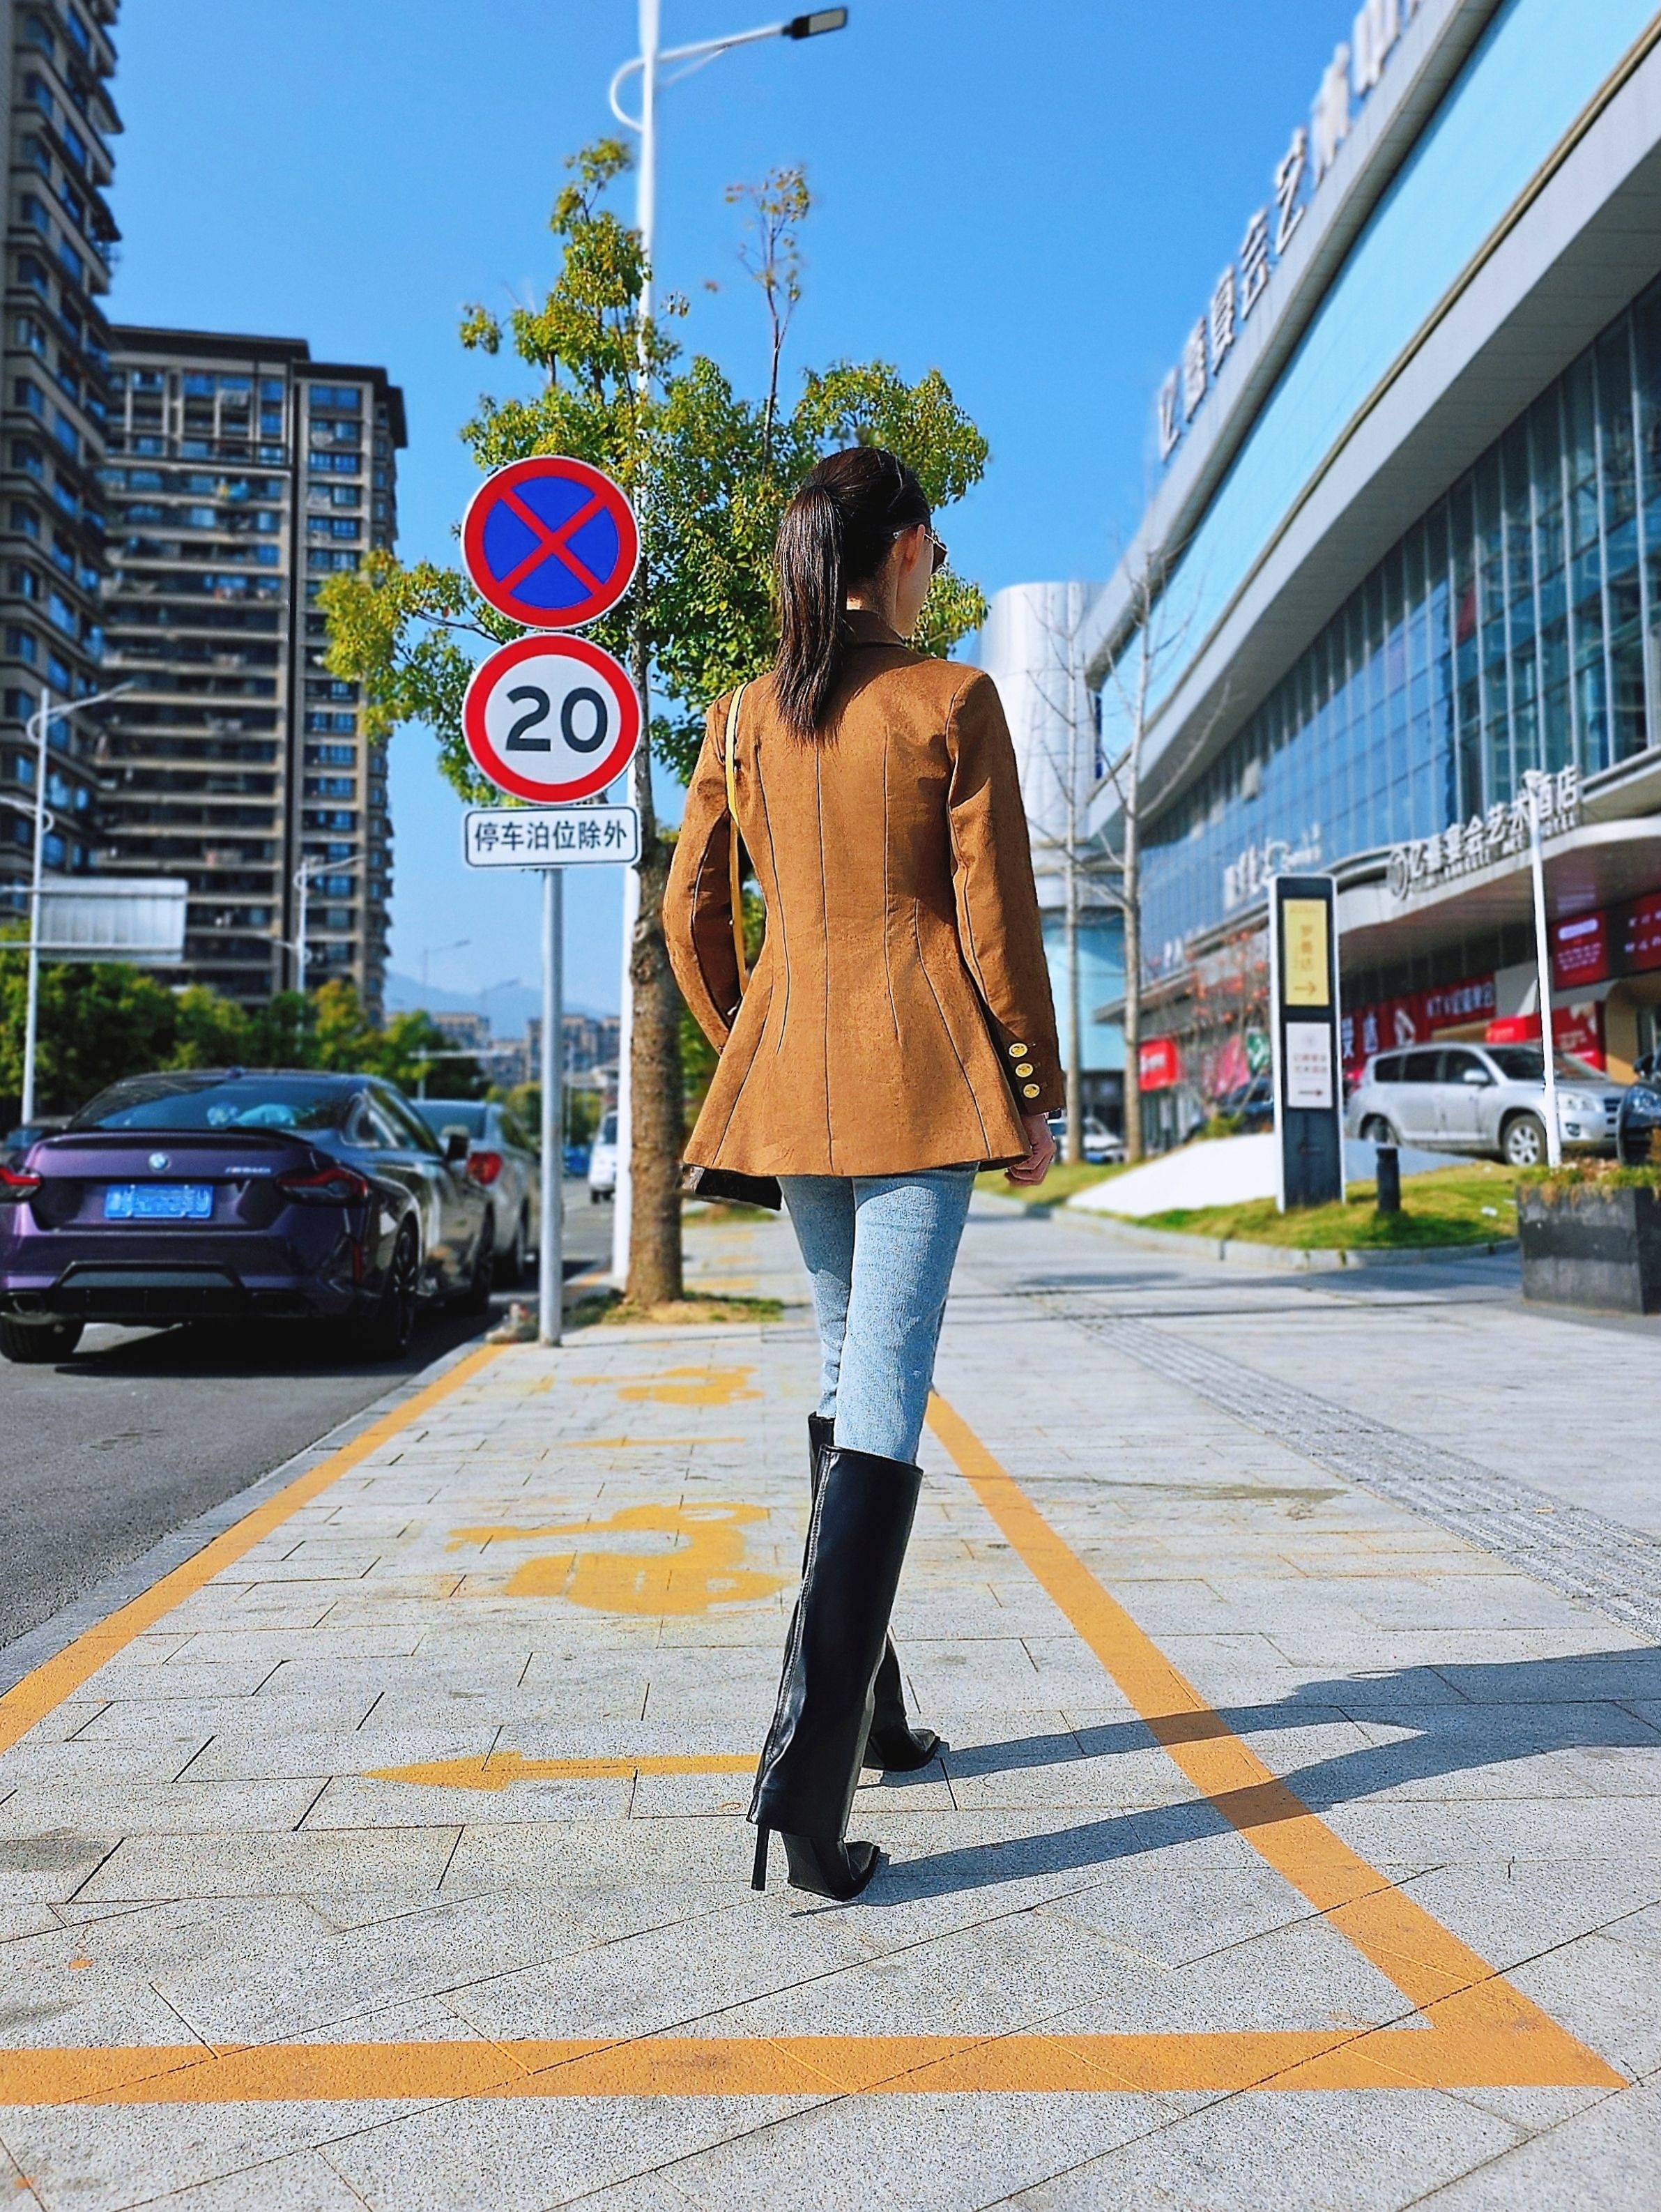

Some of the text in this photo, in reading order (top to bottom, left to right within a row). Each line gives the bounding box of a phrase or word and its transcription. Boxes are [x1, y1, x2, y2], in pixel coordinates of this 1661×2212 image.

[505, 685, 608, 753] 20
[475, 818, 627, 852] 停车泊位除外
